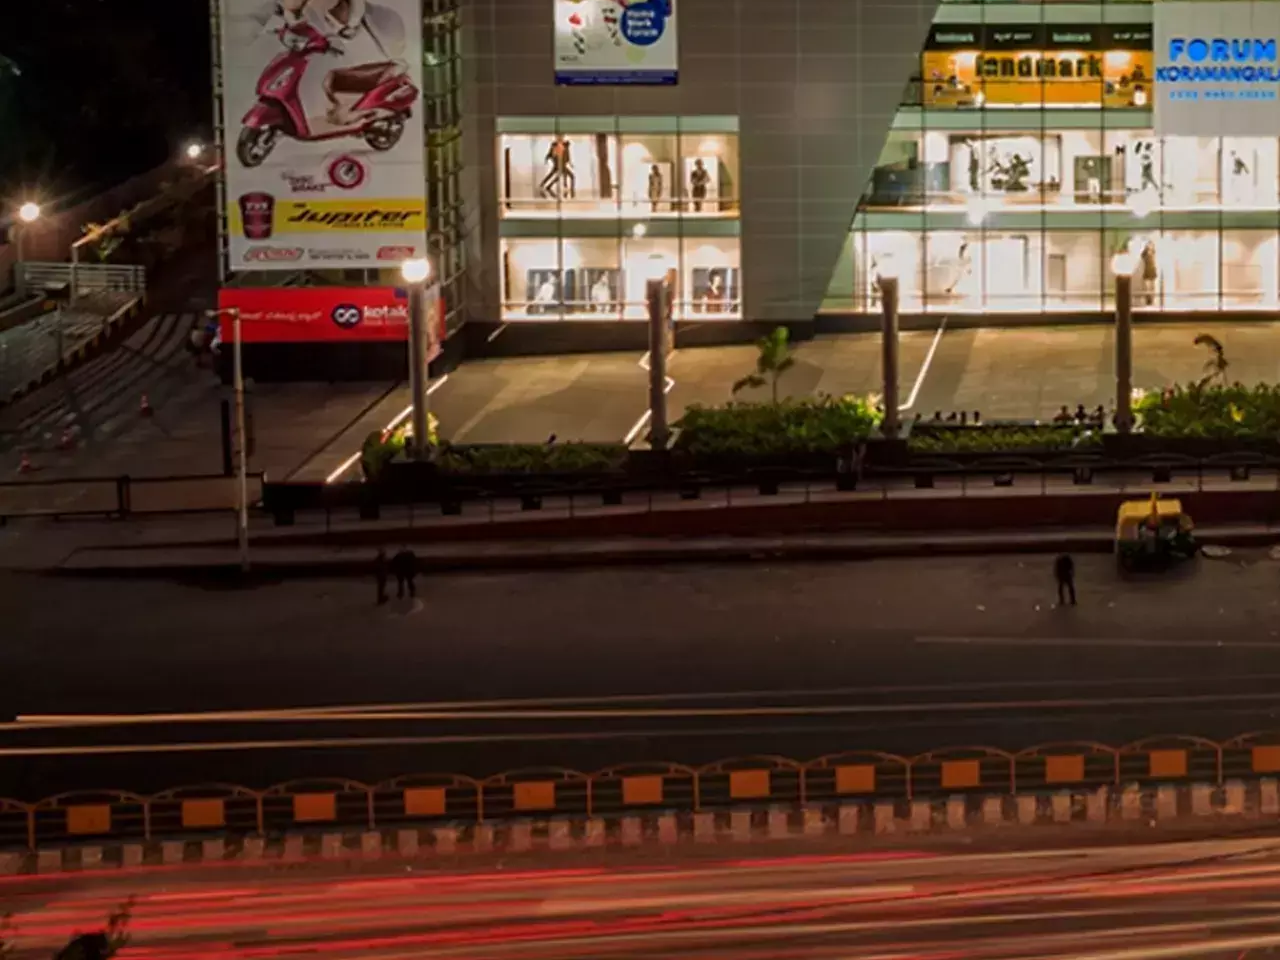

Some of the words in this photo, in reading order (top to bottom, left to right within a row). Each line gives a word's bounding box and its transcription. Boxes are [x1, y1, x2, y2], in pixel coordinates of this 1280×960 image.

[1169, 38, 1277, 61] FORUM
[975, 54, 1103, 77] landmark
[287, 209, 422, 225] Jupiter
